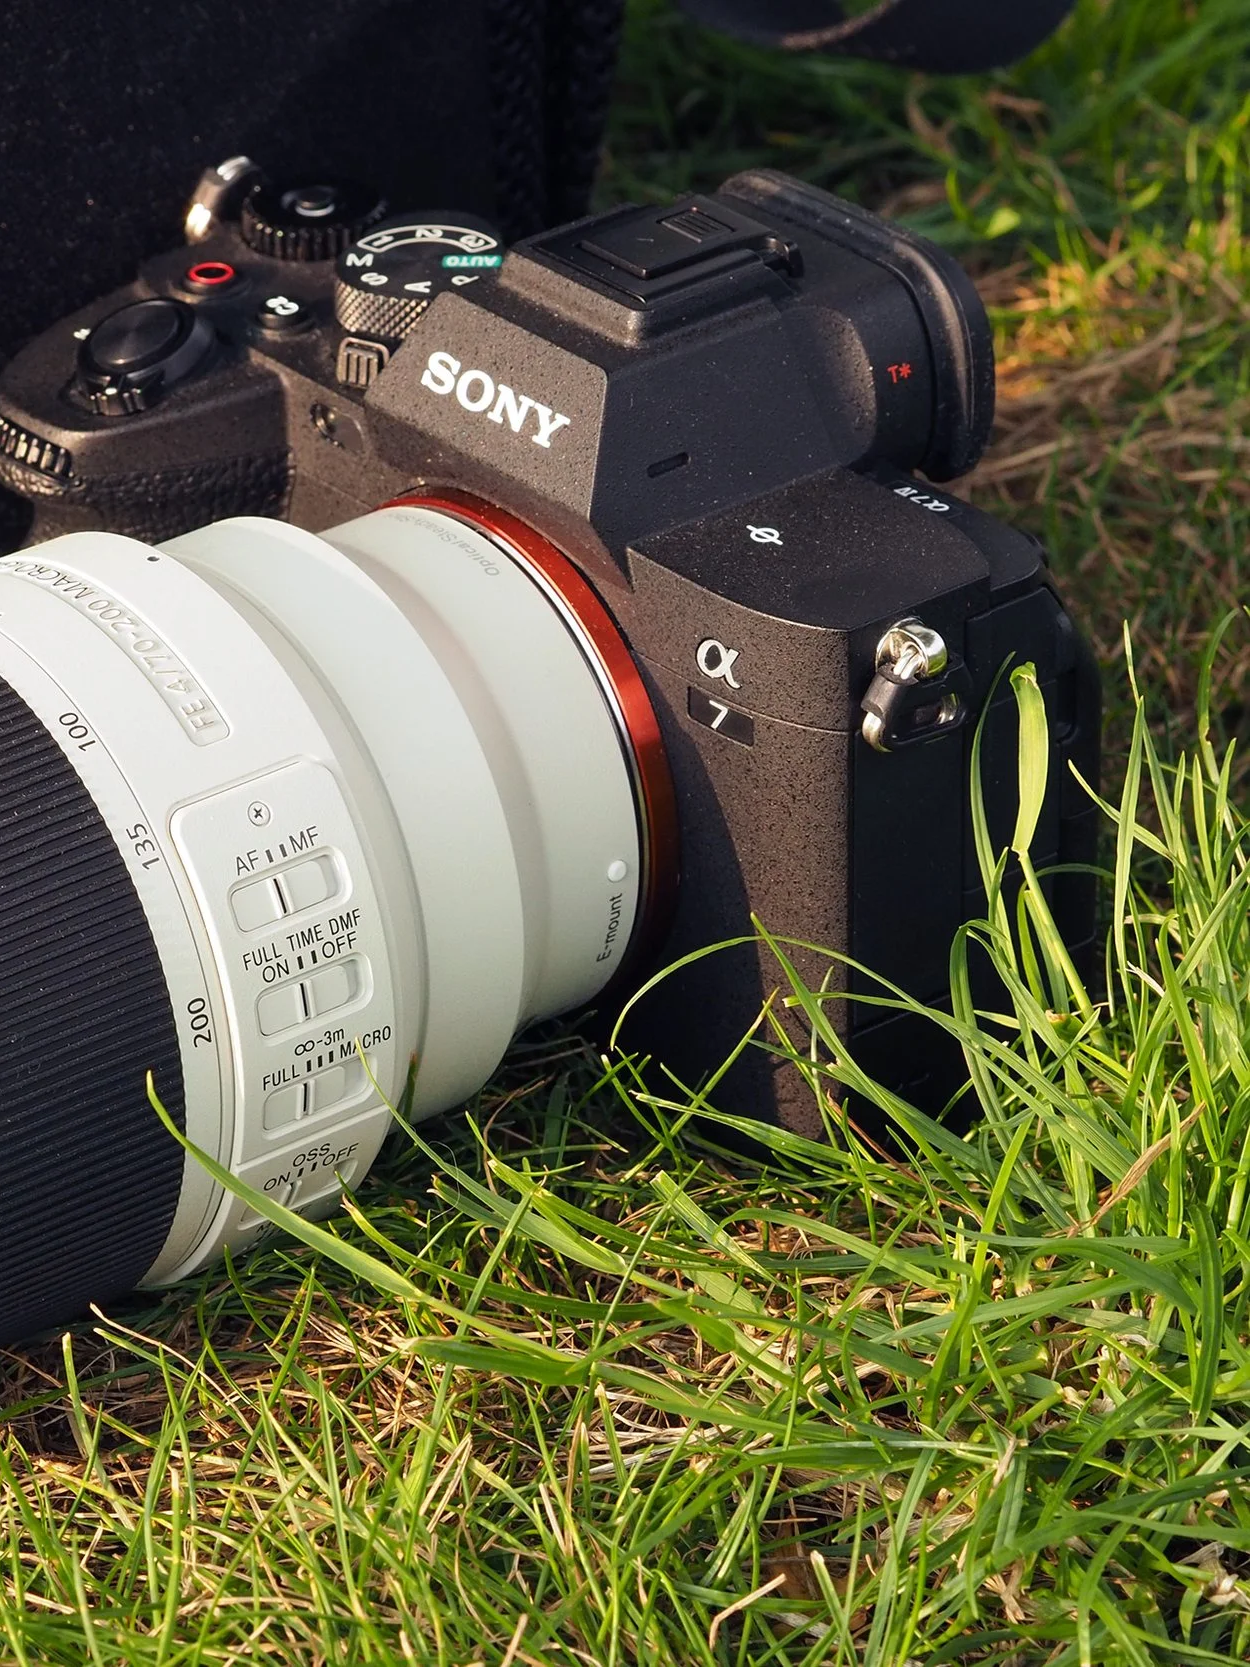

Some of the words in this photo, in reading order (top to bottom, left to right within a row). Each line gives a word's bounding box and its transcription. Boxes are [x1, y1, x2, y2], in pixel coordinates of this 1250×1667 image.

[373, 235, 394, 247] 1
[415, 228, 443, 239] 2
[460, 235, 485, 248] 3
[346, 253, 374, 266] M
[445, 256, 498, 266] AUTO
[360, 272, 389, 286] S
[404, 281, 432, 293] A
[451, 275, 479, 286] P
[420, 351, 571, 449] SONY
[15, 563, 94, 599] MACRO
[59, 712, 96, 752] 100
[181, 697, 215, 733] FE
[709, 699, 729, 730] 7
[126, 823, 160, 870] 135
[235, 850, 260, 876] AF
[288, 825, 319, 853] MF
[242, 942, 282, 971] FULL
[286, 924, 324, 951] TIME
[328, 908, 361, 936] DMF
[596, 893, 623, 963] E-mount
[262, 959, 290, 983] ON
[322, 931, 358, 959] OFF
[187, 998, 212, 1047] 200
[262, 1064, 300, 1091] FULL
[263, 1171, 291, 1191] ON
[322, 1143, 359, 1167] OFF
[293, 1143, 330, 1167] OSS
